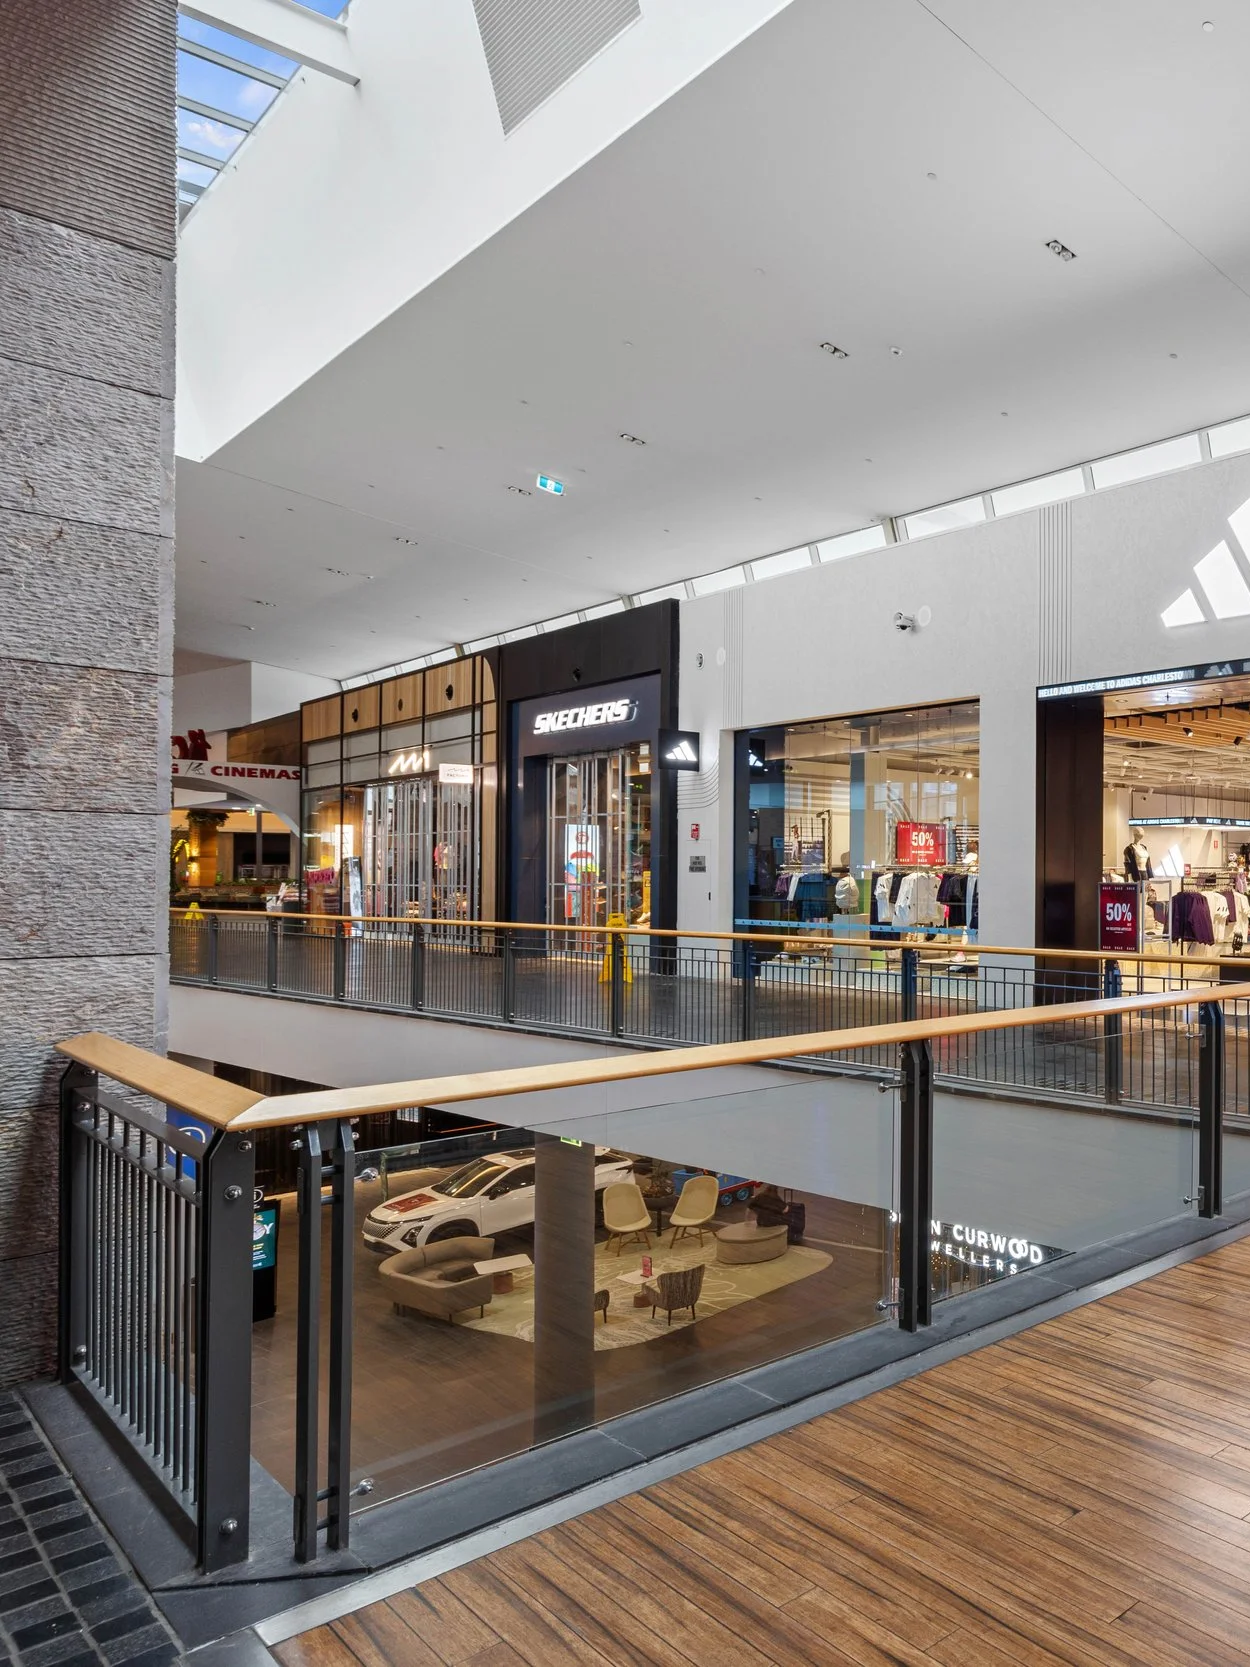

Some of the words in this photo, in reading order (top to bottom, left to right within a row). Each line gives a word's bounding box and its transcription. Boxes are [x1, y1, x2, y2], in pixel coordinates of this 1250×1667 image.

[1038, 688, 1058, 699] HELLO
[1059, 685, 1073, 696] AND
[1106, 679, 1115, 690] TO
[1116, 676, 1142, 688] ADIDAS
[1142, 669, 1195, 684] CHARLESTOWN
[533, 699, 632, 735] SKECHERS
[210, 765, 300, 780] CINEMAS
[911, 831, 934, 847] 50%
[1105, 902, 1132, 922] 50%
[930, 1240, 1018, 1275] WELLERS
[952, 1224, 1043, 1263] CURWOOD
